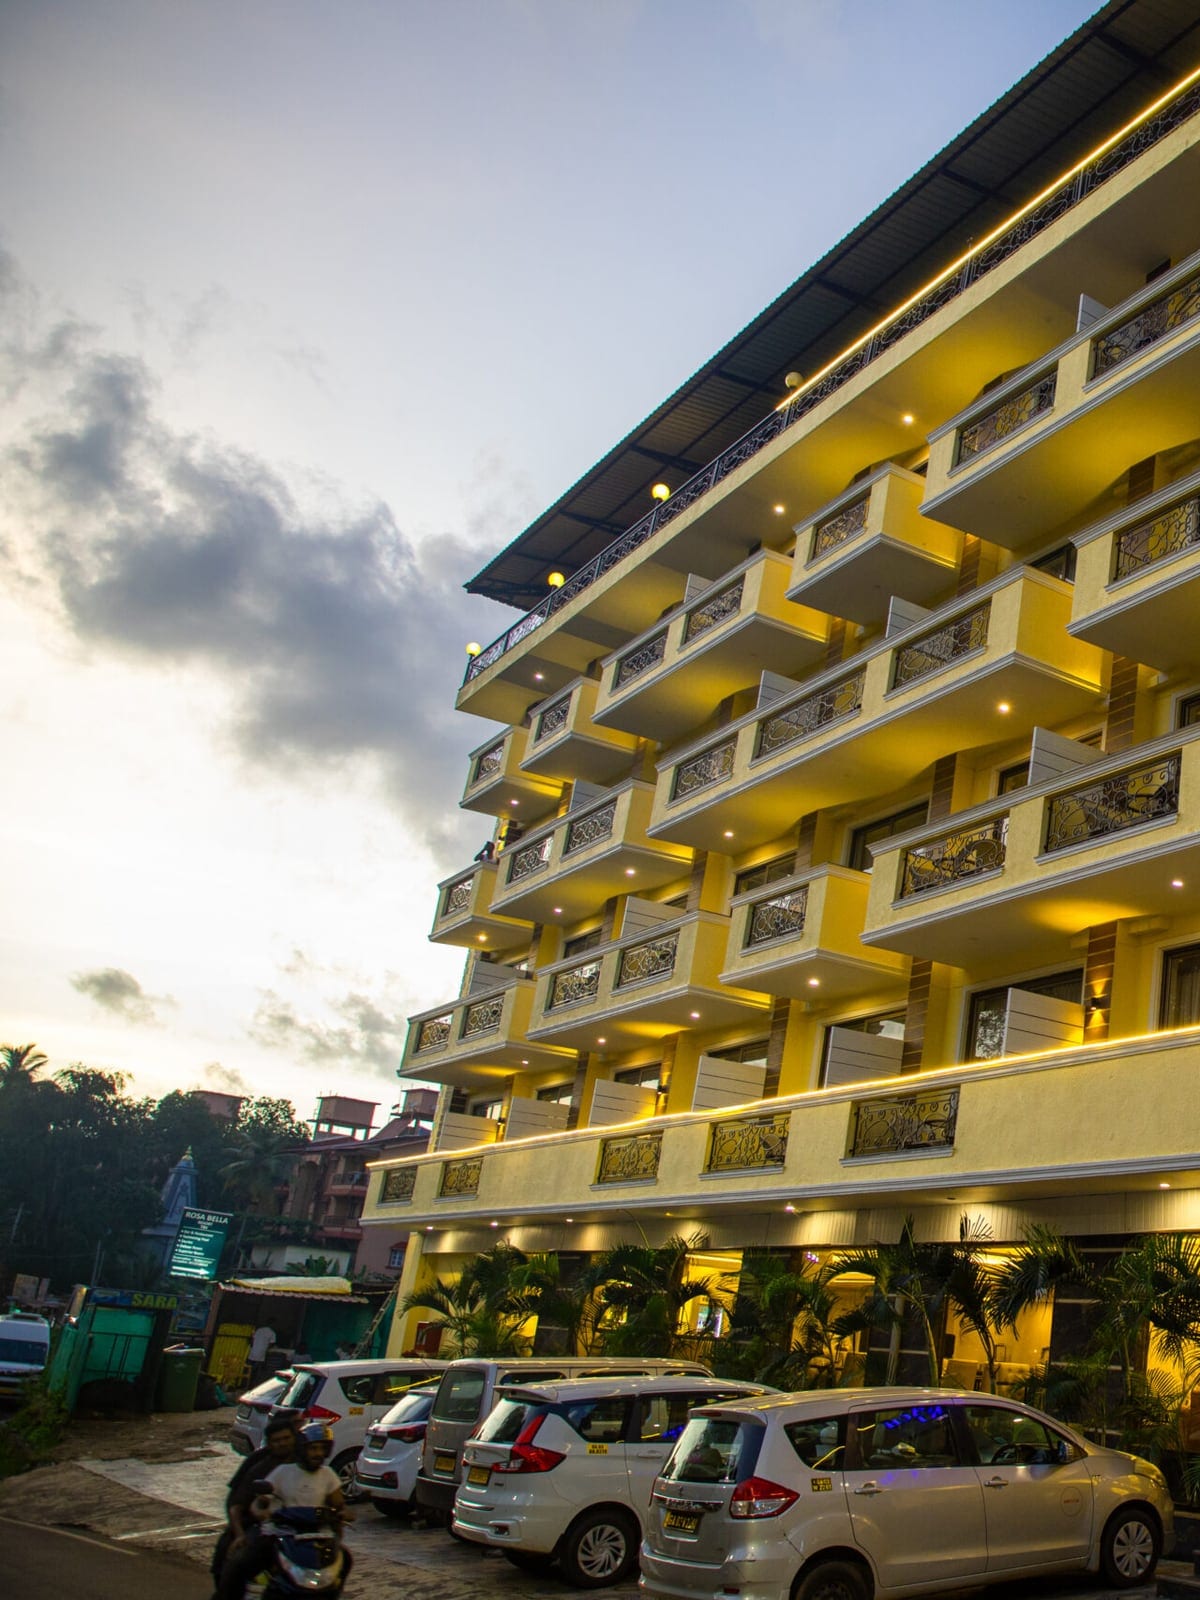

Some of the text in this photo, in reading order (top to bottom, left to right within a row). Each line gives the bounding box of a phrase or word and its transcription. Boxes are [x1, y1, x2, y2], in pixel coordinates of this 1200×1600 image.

[185, 1212, 228, 1224] ROSA BELLA
[132, 1293, 177, 1309] SARA
